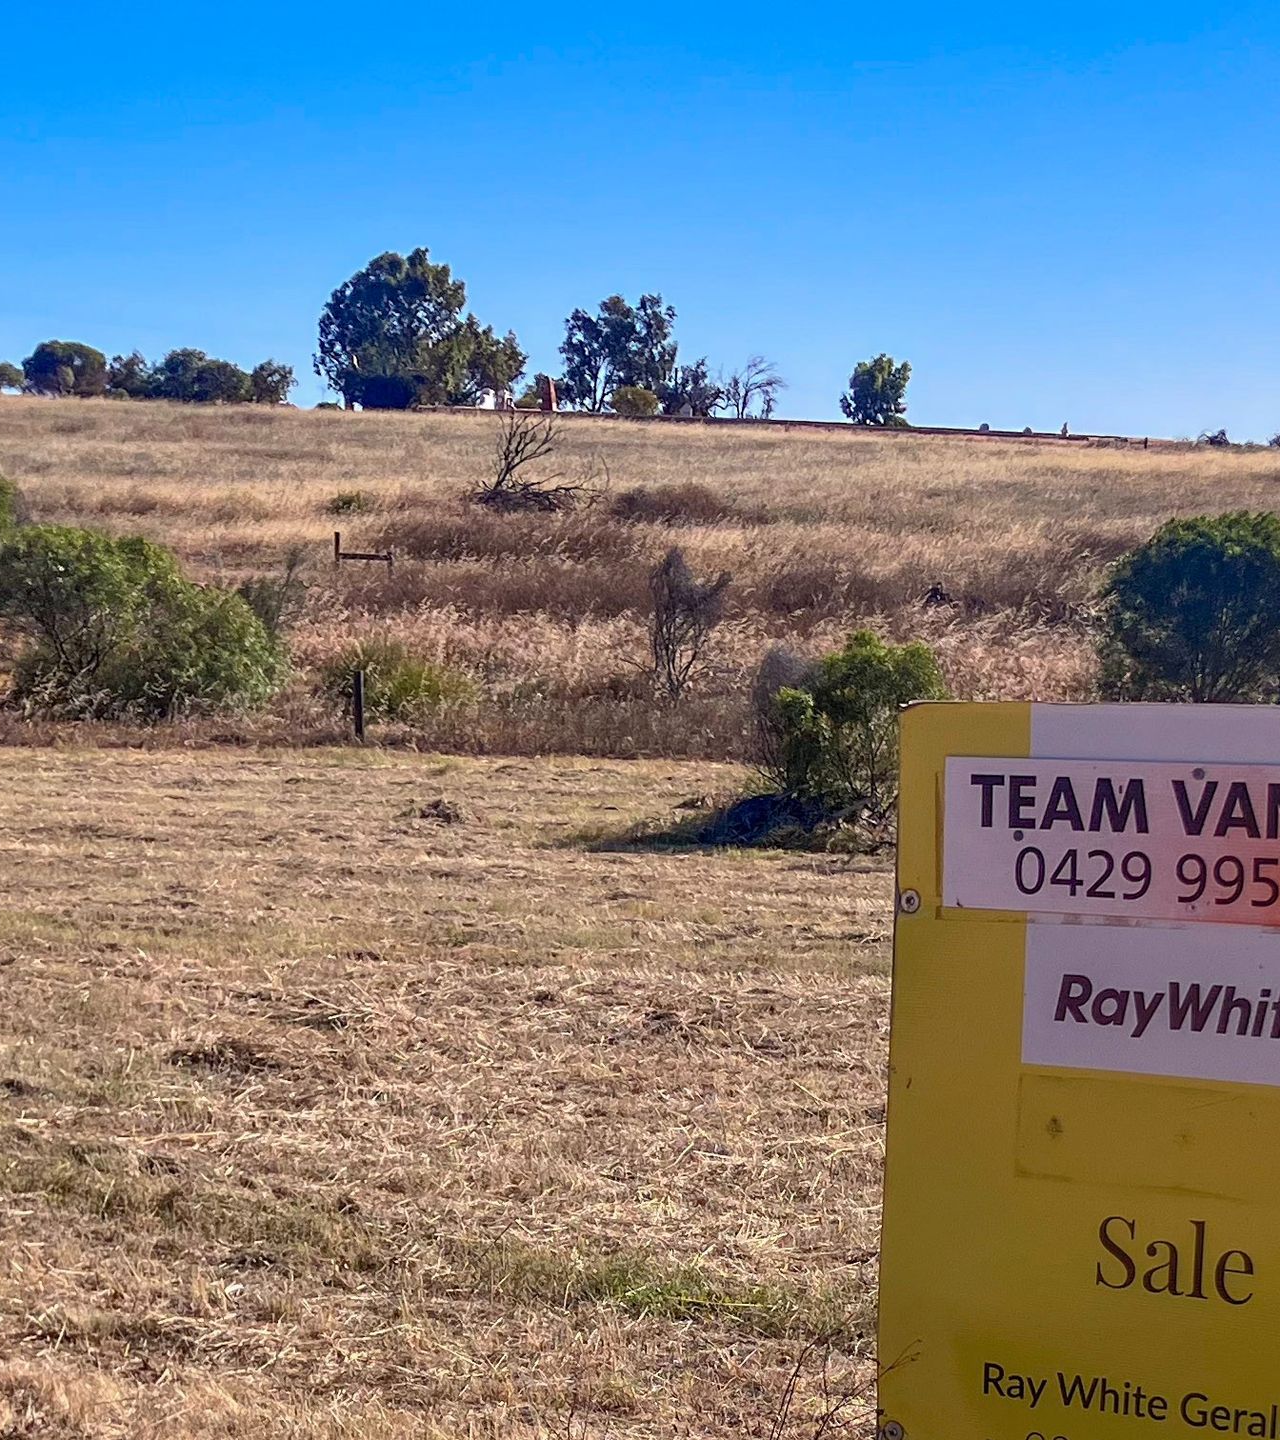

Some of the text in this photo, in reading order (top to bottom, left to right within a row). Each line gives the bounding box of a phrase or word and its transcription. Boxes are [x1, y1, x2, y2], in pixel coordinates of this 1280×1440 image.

[970, 774, 1150, 834] TEAM
[1015, 846, 1152, 901] 0429
[1176, 853, 1279, 907] 995
[1095, 1214, 1255, 1305] Sale
[981, 1360, 1047, 1408] Ray
[1056, 1371, 1169, 1421] White
